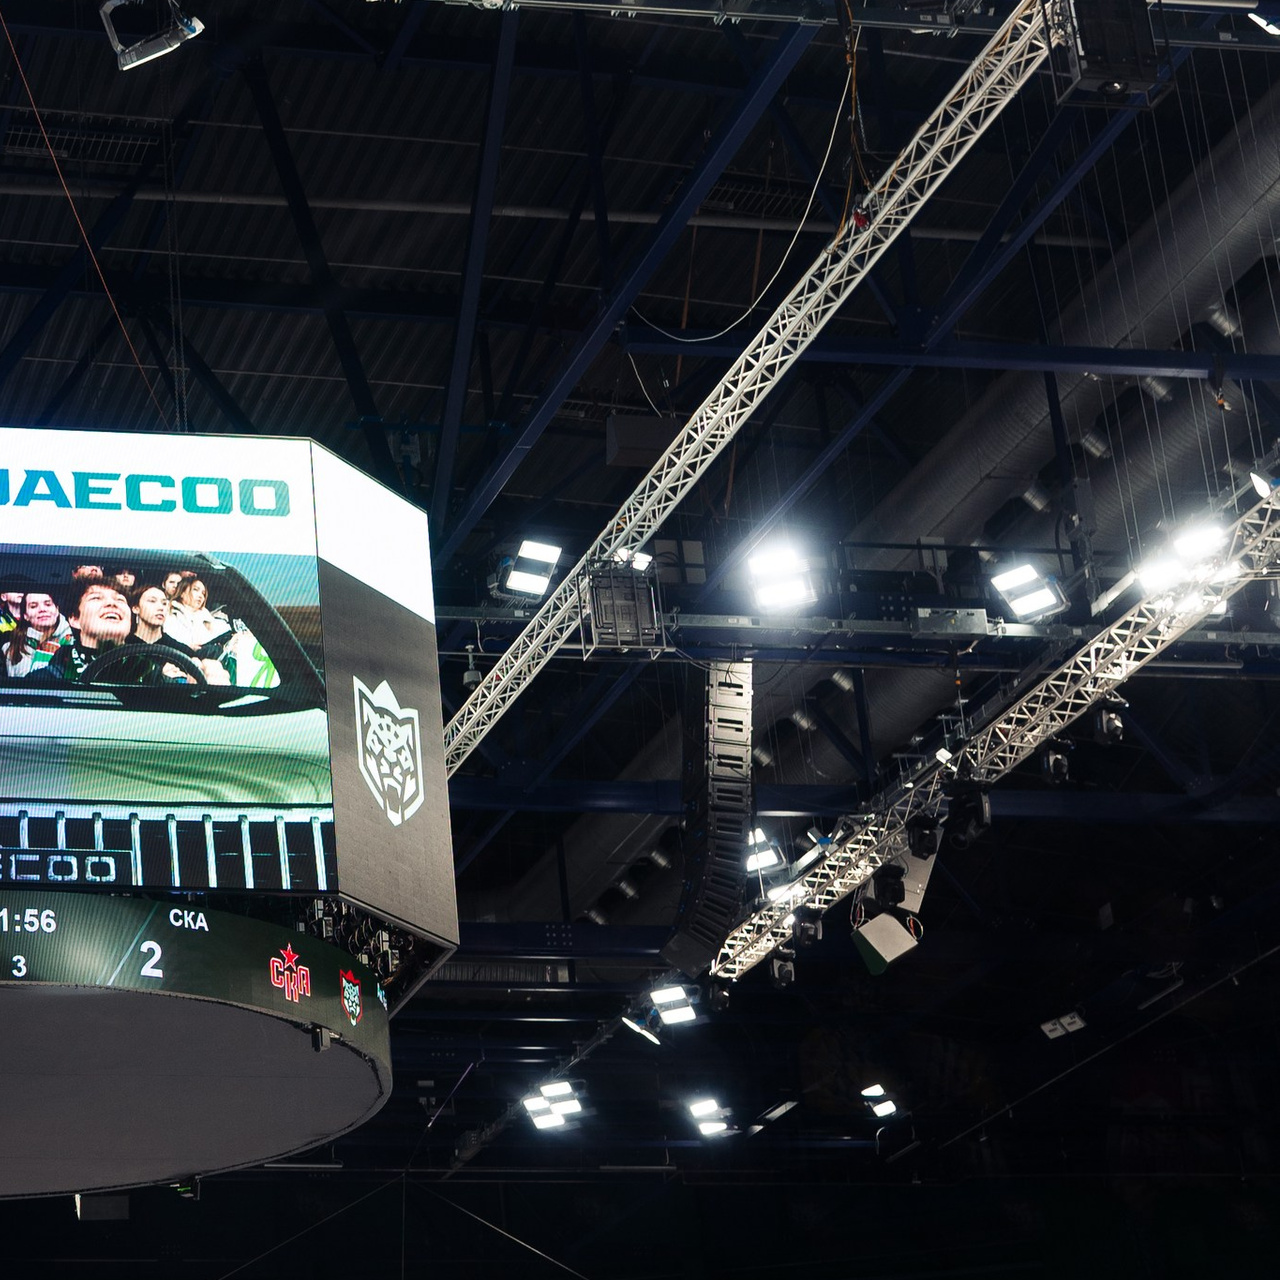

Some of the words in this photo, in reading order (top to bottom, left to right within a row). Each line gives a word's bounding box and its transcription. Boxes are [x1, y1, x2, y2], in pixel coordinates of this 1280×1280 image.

[169, 909, 209, 931] СКА
[12, 955, 27, 977] 3
[140, 941, 163, 978] 2
[270, 957, 311, 1003] СКА
